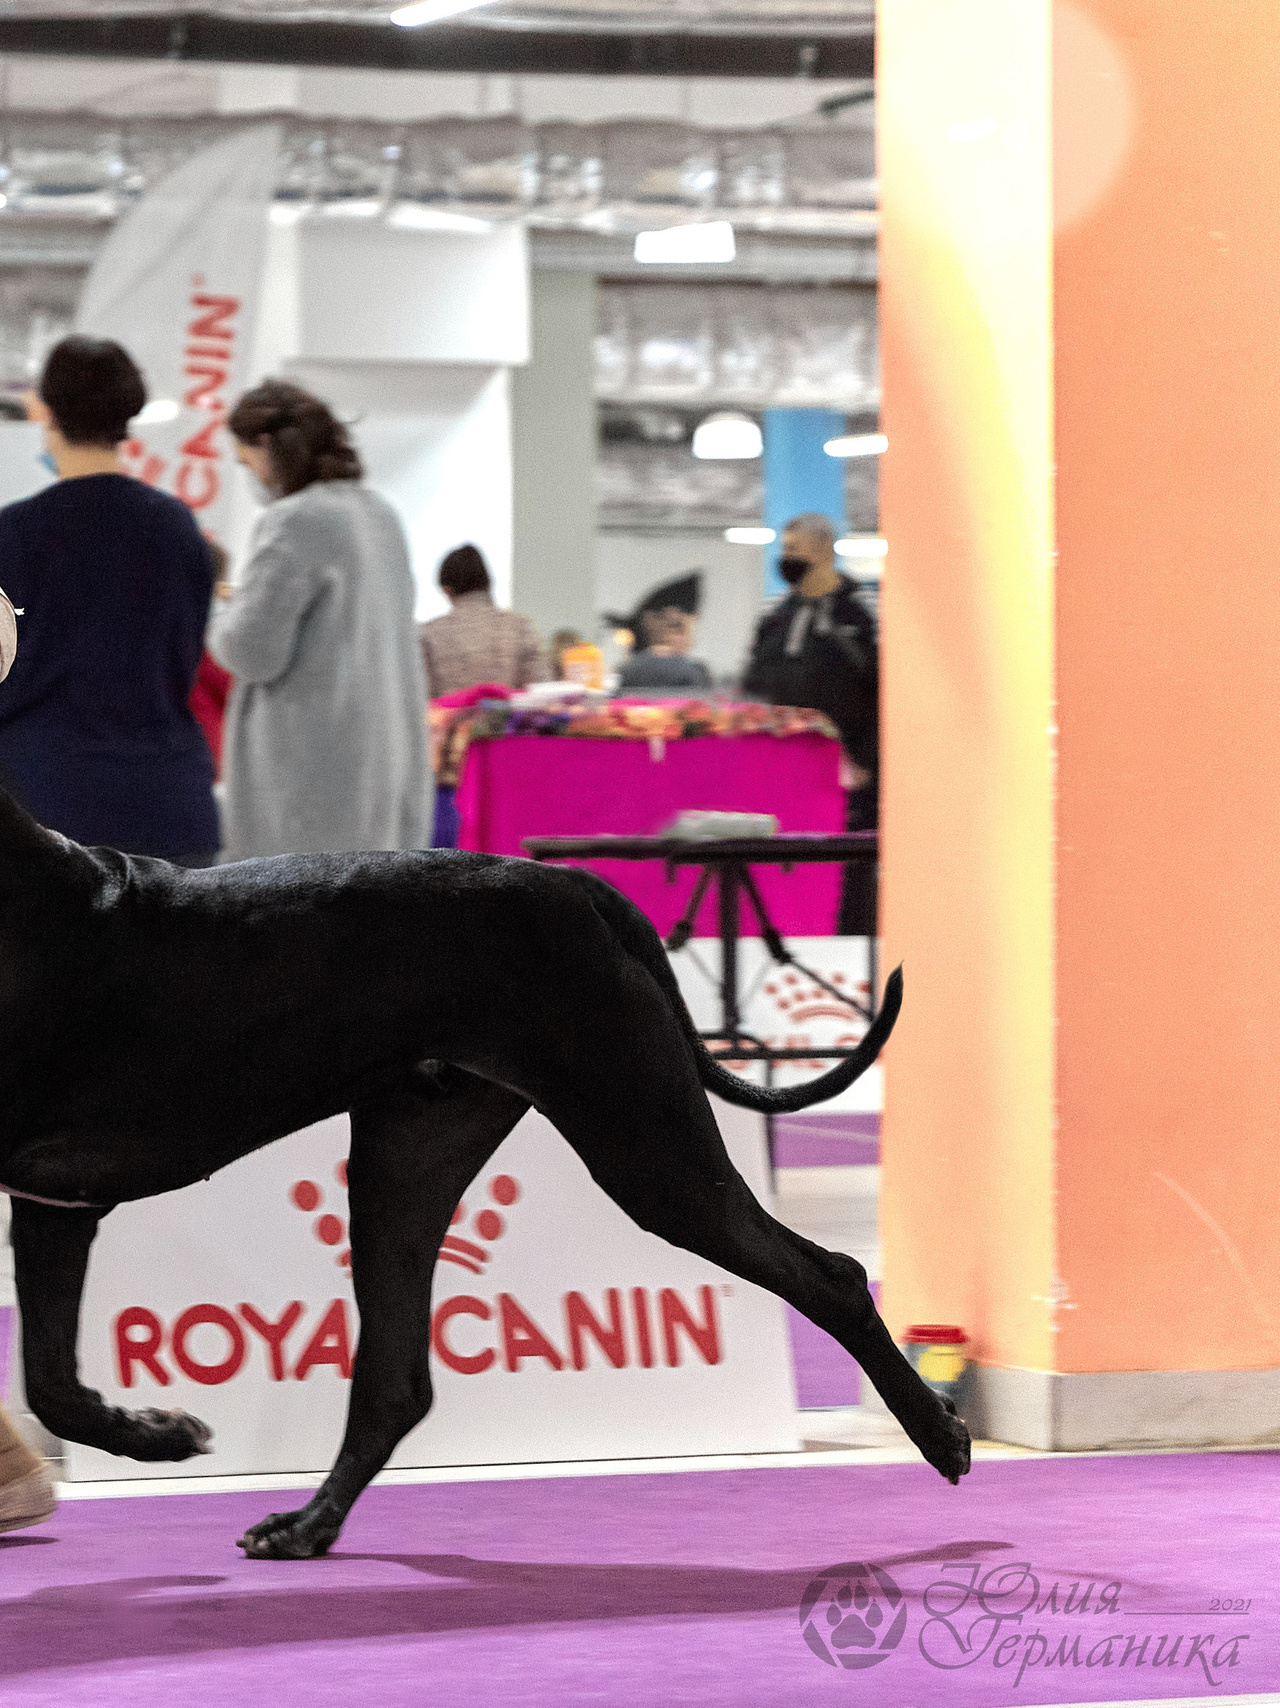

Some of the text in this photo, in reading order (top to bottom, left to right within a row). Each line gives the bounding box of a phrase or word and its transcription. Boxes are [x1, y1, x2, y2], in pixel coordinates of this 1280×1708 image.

[176, 293, 241, 510] CANIN
[112, 1284, 723, 1388] ROYA CANIN
